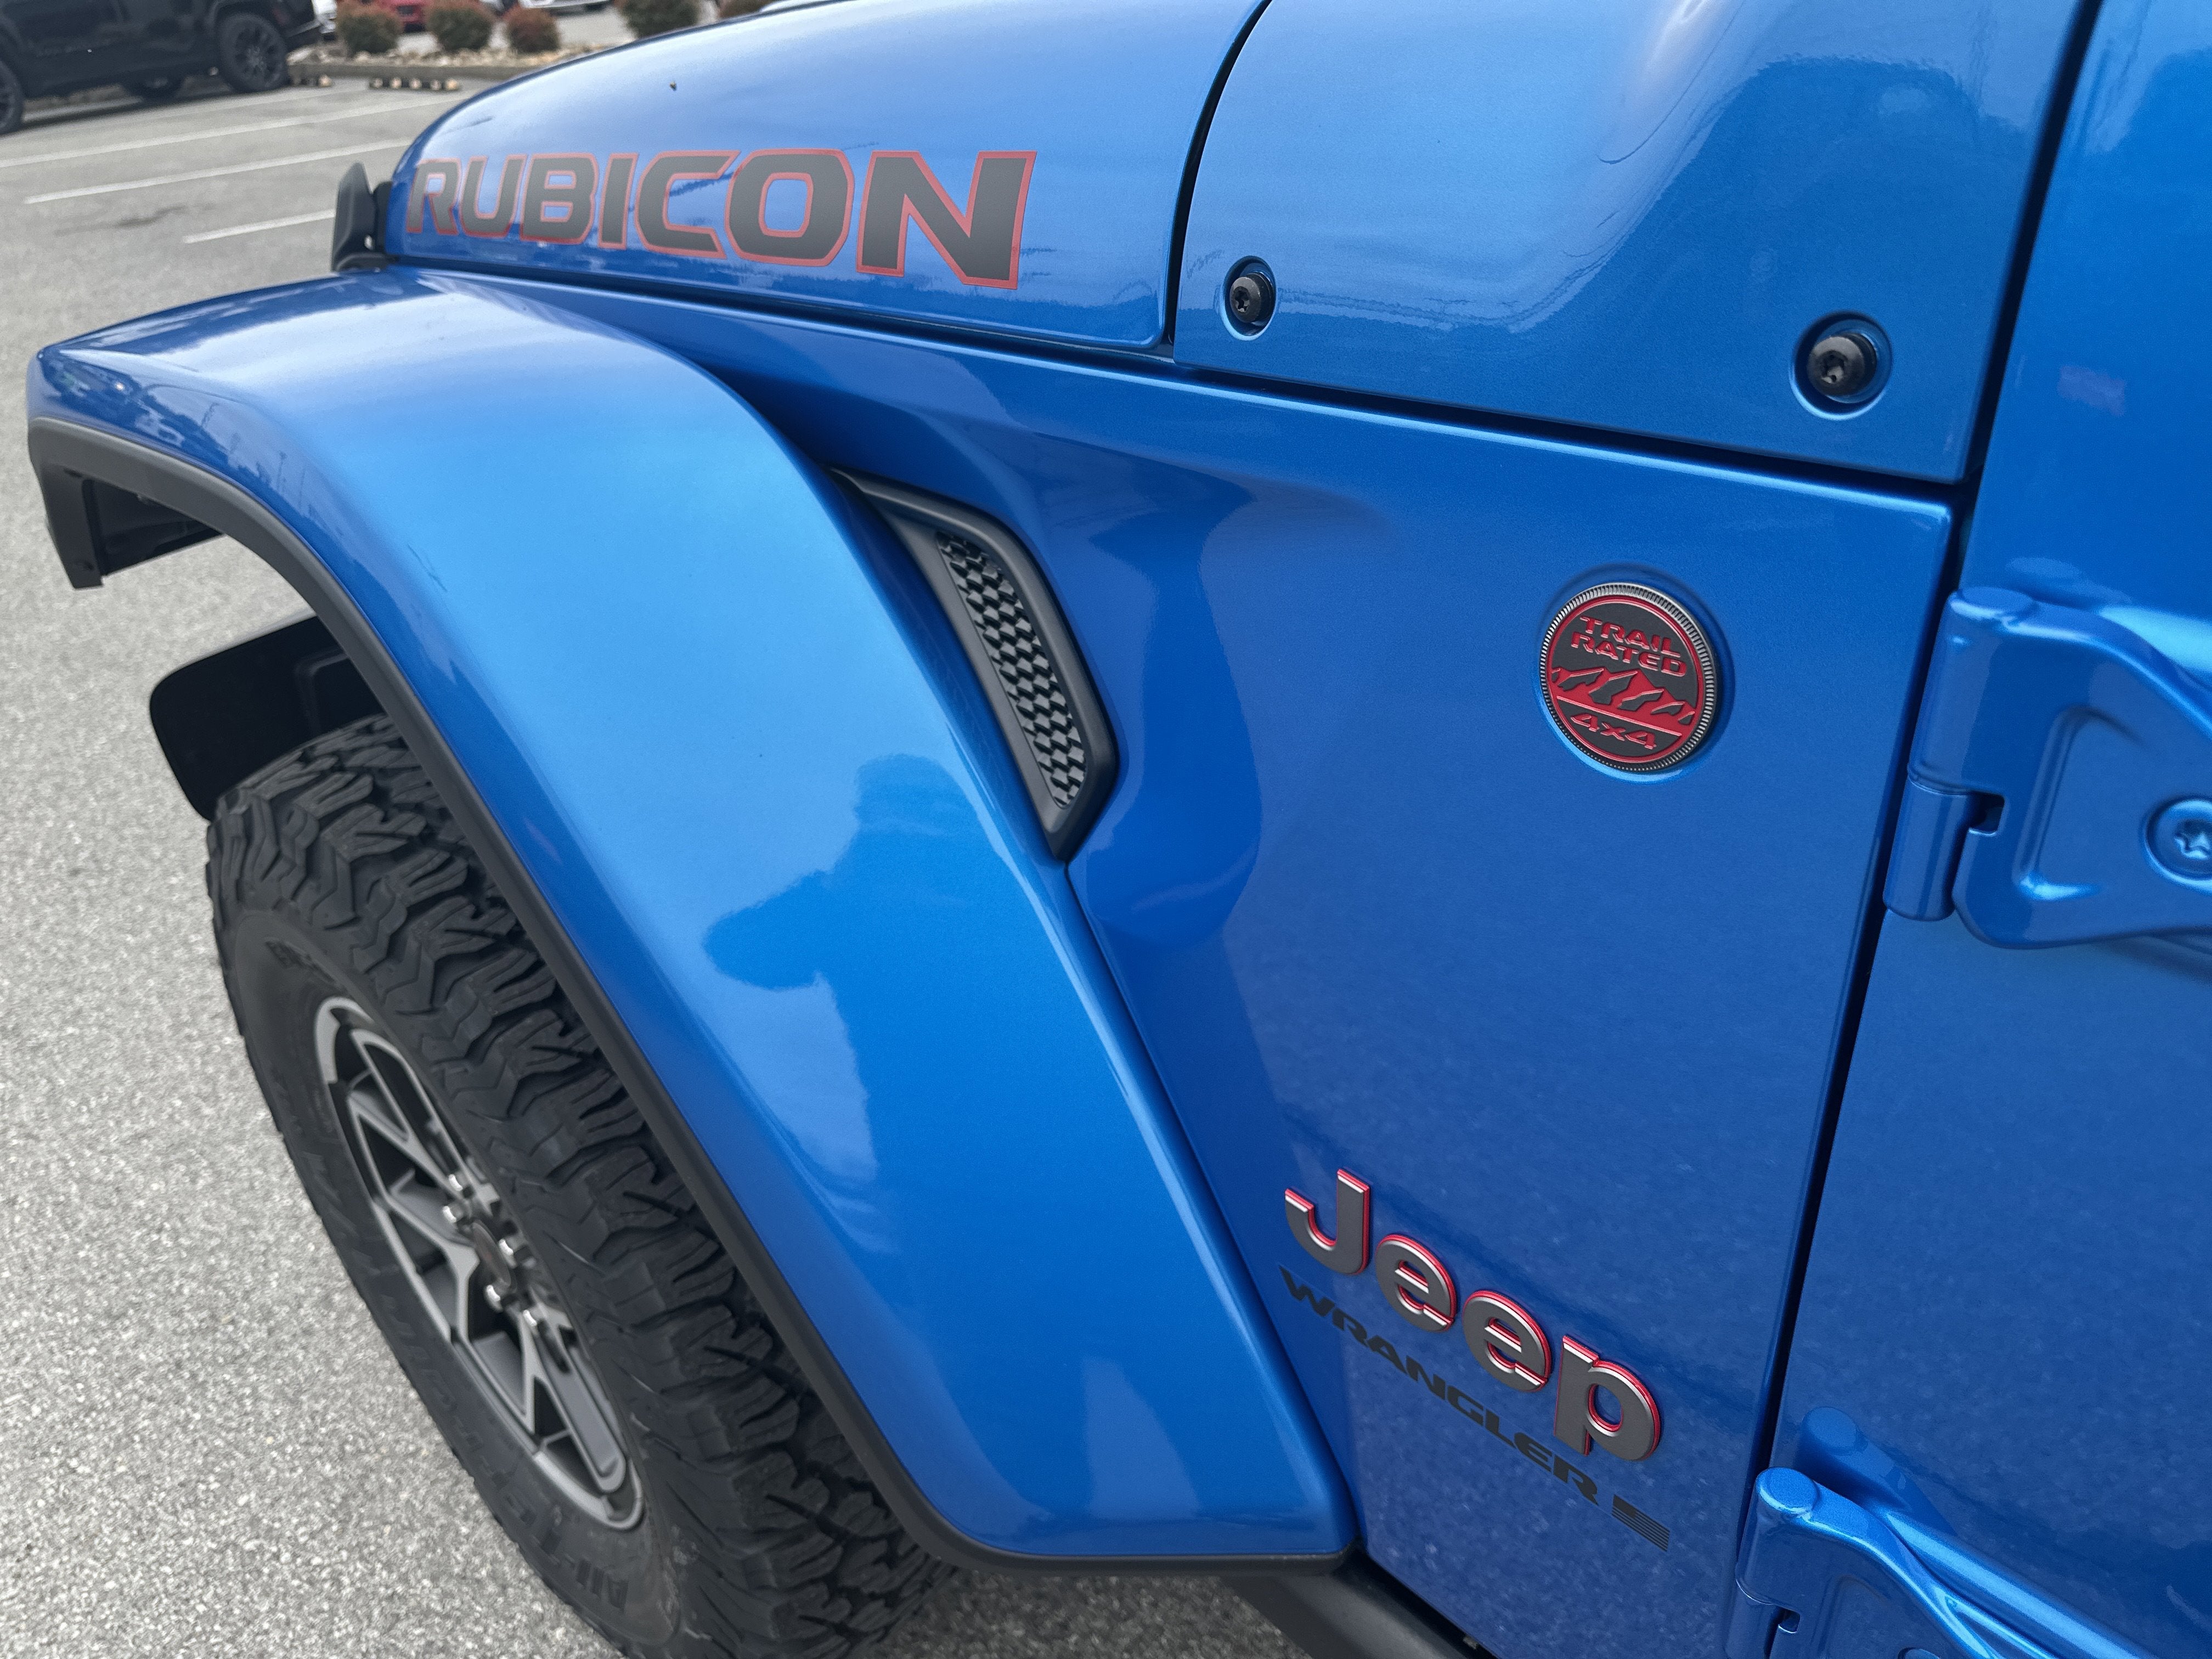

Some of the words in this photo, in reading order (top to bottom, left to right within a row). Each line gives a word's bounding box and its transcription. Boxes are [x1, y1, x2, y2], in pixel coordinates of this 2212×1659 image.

[407, 149, 1036, 290] RUBICON
[1571, 631, 1687, 677] RATED
[1579, 616, 1680, 657] TRAIL
[1279, 1265, 1599, 1505] WRANGLER
[1284, 1169, 1662, 1461] Jeep
